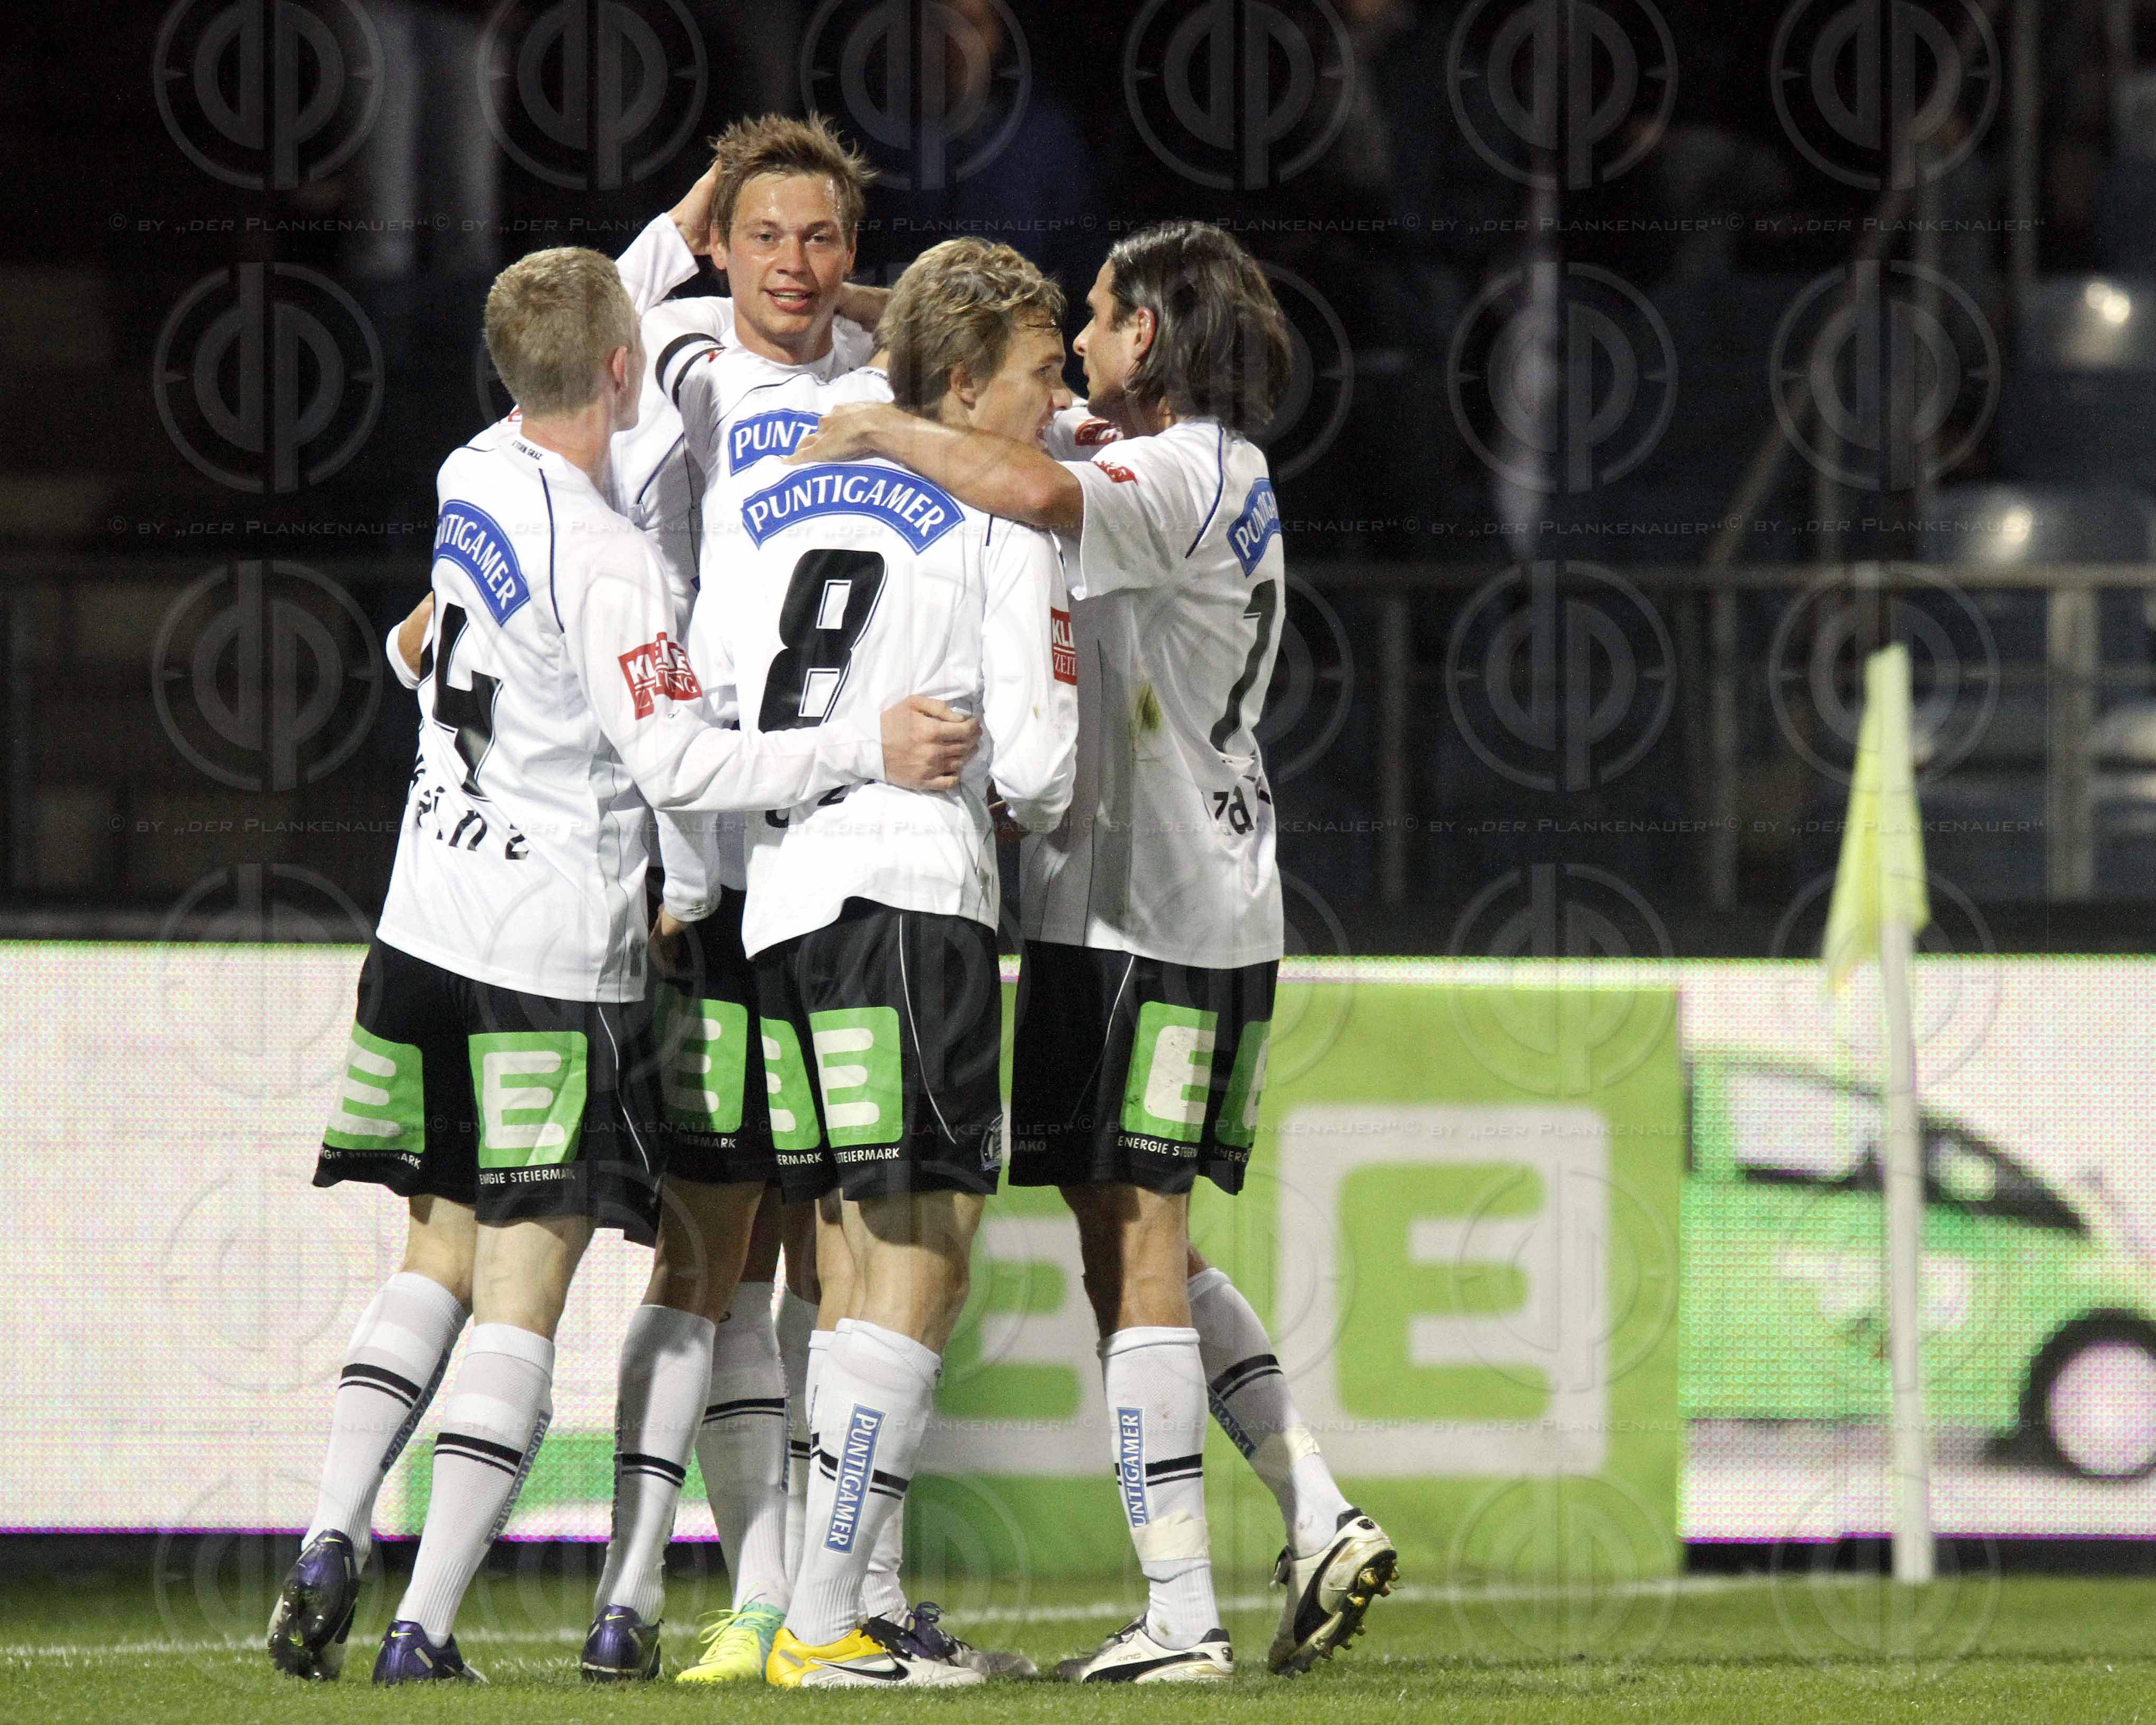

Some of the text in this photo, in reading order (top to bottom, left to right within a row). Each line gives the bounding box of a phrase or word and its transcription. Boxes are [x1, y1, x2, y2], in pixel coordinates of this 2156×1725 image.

[747, 475, 946, 537] PUNTIGAMER
[758, 548, 888, 734] 8
[482, 1051, 565, 1149] E
[1144, 1025, 1215, 1125] E
[1117, 1135, 1169, 1155] ENERGIE
[828, 1411, 879, 1546] PUNTIGAMER
[1120, 1414, 1147, 1527] UNTIGAMER
